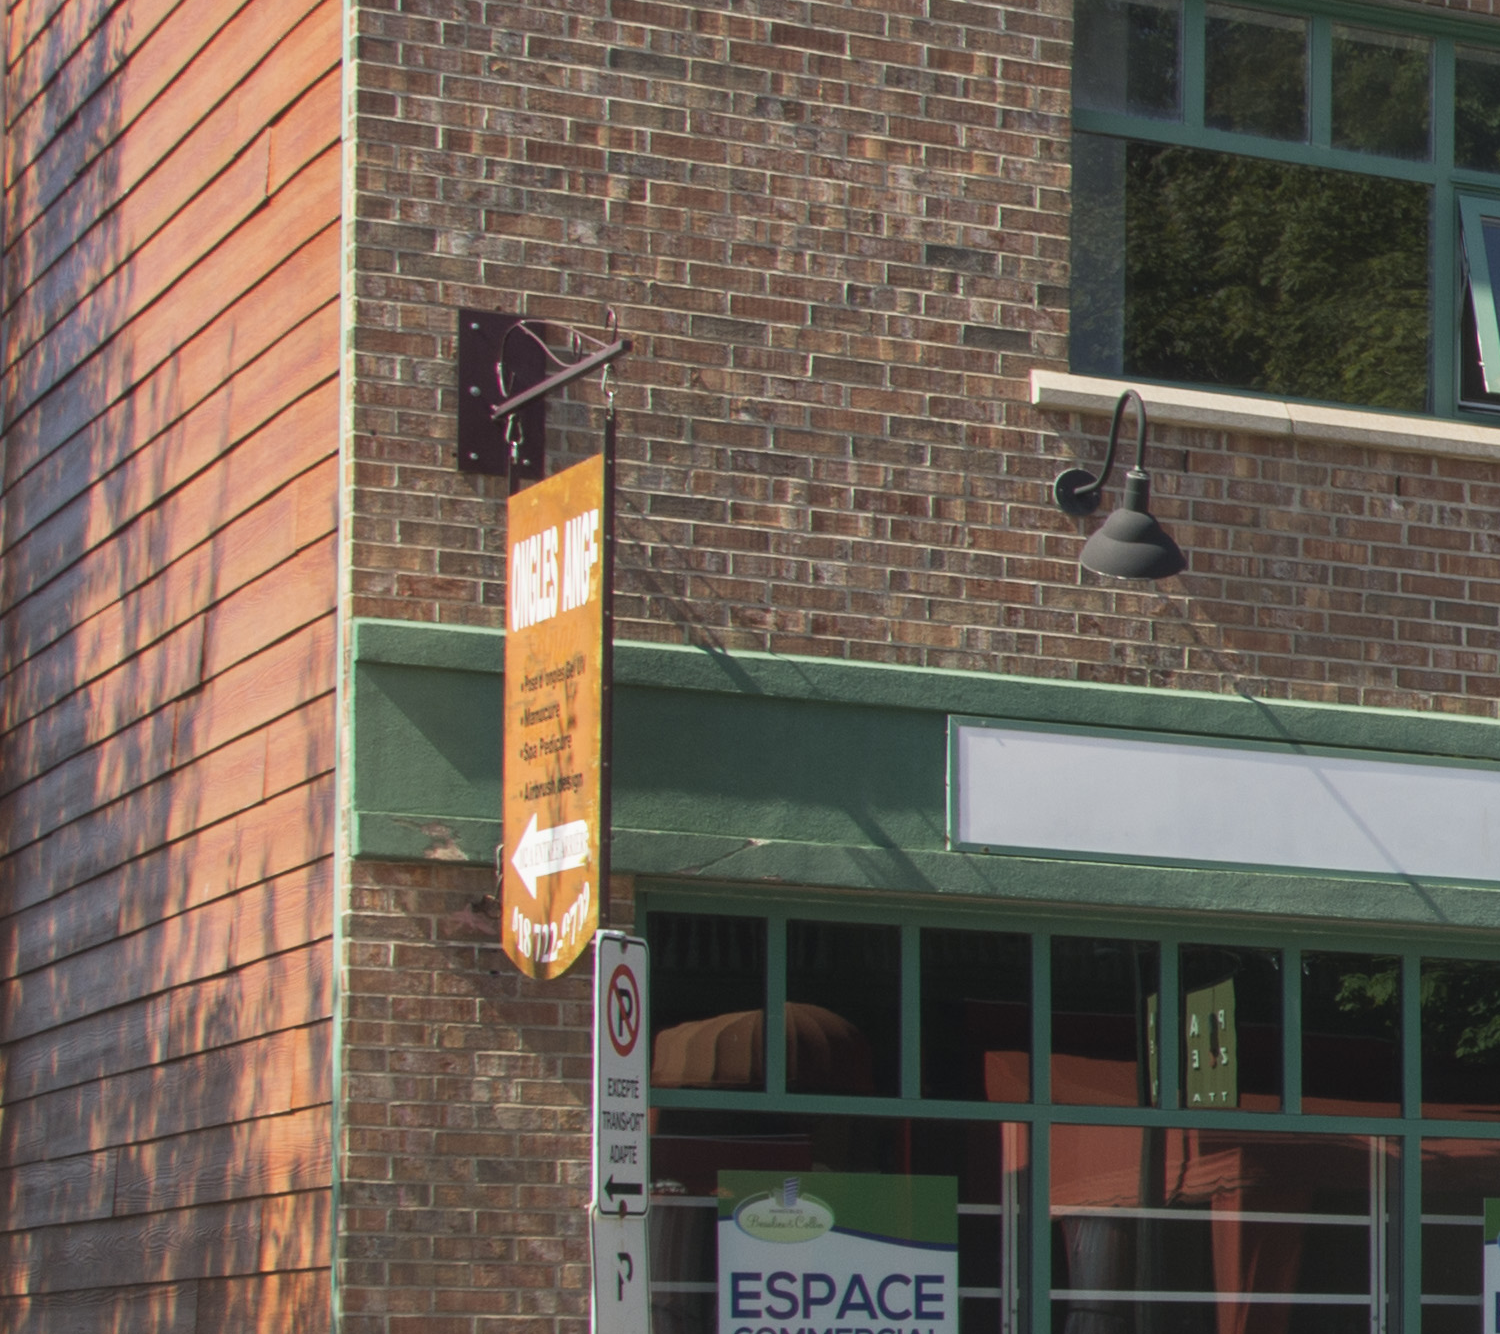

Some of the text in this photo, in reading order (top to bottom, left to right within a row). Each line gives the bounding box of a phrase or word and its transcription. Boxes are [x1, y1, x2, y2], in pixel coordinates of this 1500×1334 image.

[510, 525, 559, 633] ONGLES
[607, 1074, 640, 1100] EXCEPTÉ
[609, 1140, 638, 1165] ADAPTÉ
[730, 1271, 945, 1321] ESPACE
